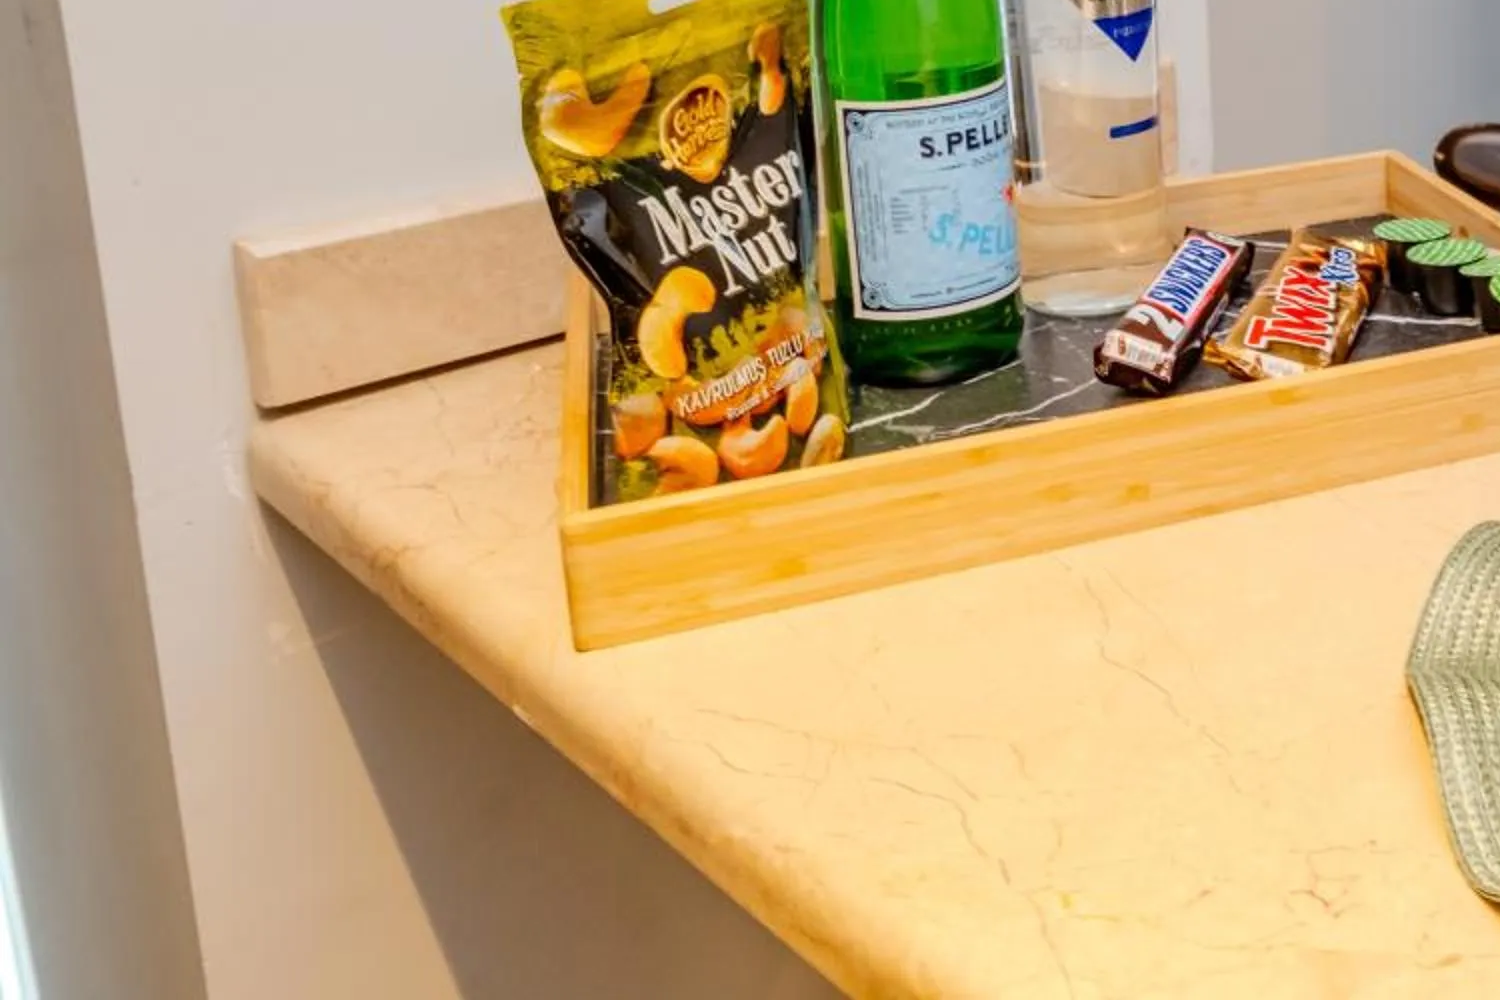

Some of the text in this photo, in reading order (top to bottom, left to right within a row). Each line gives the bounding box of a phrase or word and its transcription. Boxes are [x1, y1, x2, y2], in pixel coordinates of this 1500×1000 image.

[673, 88, 717, 137] Gold
[637, 150, 803, 265] Master
[714, 215, 797, 297] Nut
[1147, 238, 1228, 315] SNICKERS
